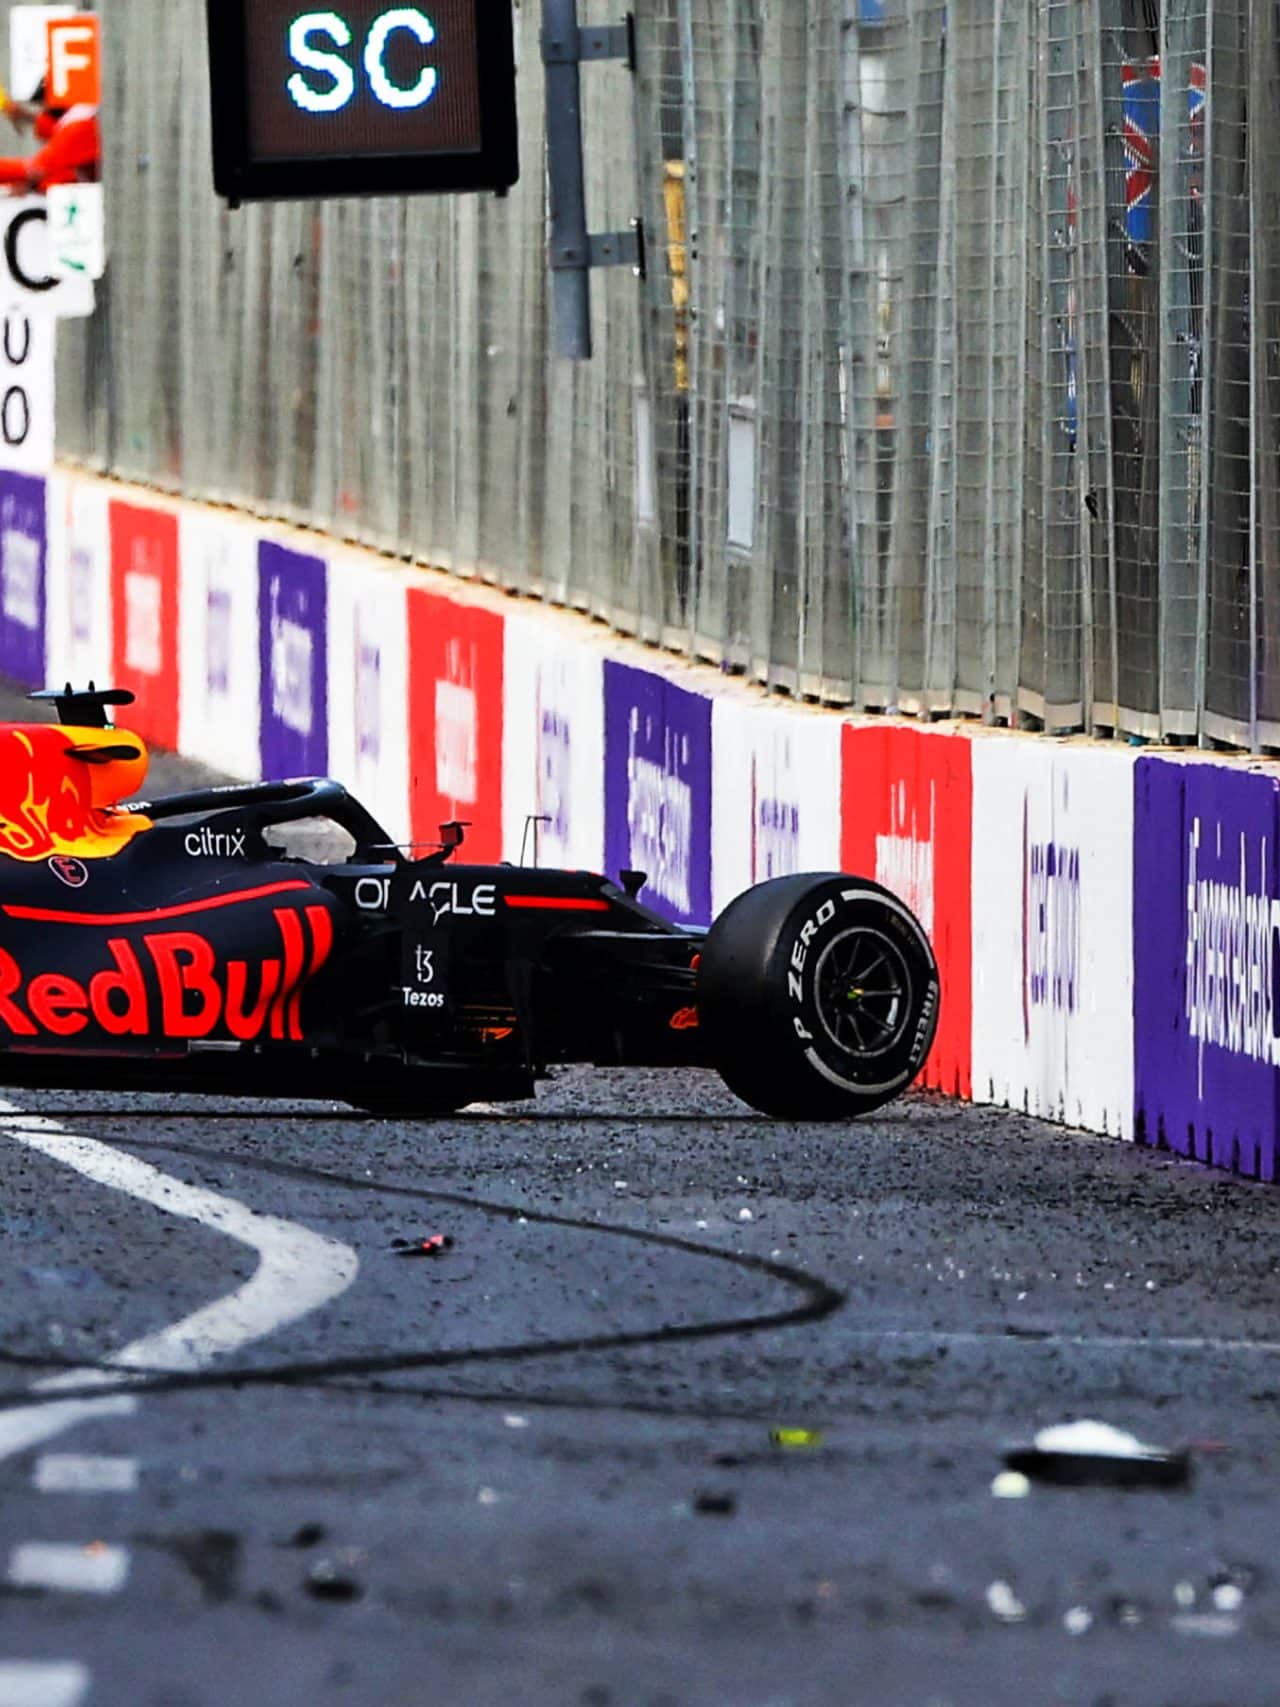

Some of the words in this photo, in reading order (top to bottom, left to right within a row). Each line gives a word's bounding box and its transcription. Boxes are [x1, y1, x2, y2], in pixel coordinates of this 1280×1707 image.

[51, 27, 94, 97] F
[287, 8, 437, 113] SC
[184, 826, 247, 857] citrix
[788, 900, 836, 1003] ZERO
[402, 987, 445, 1008] Tezos
